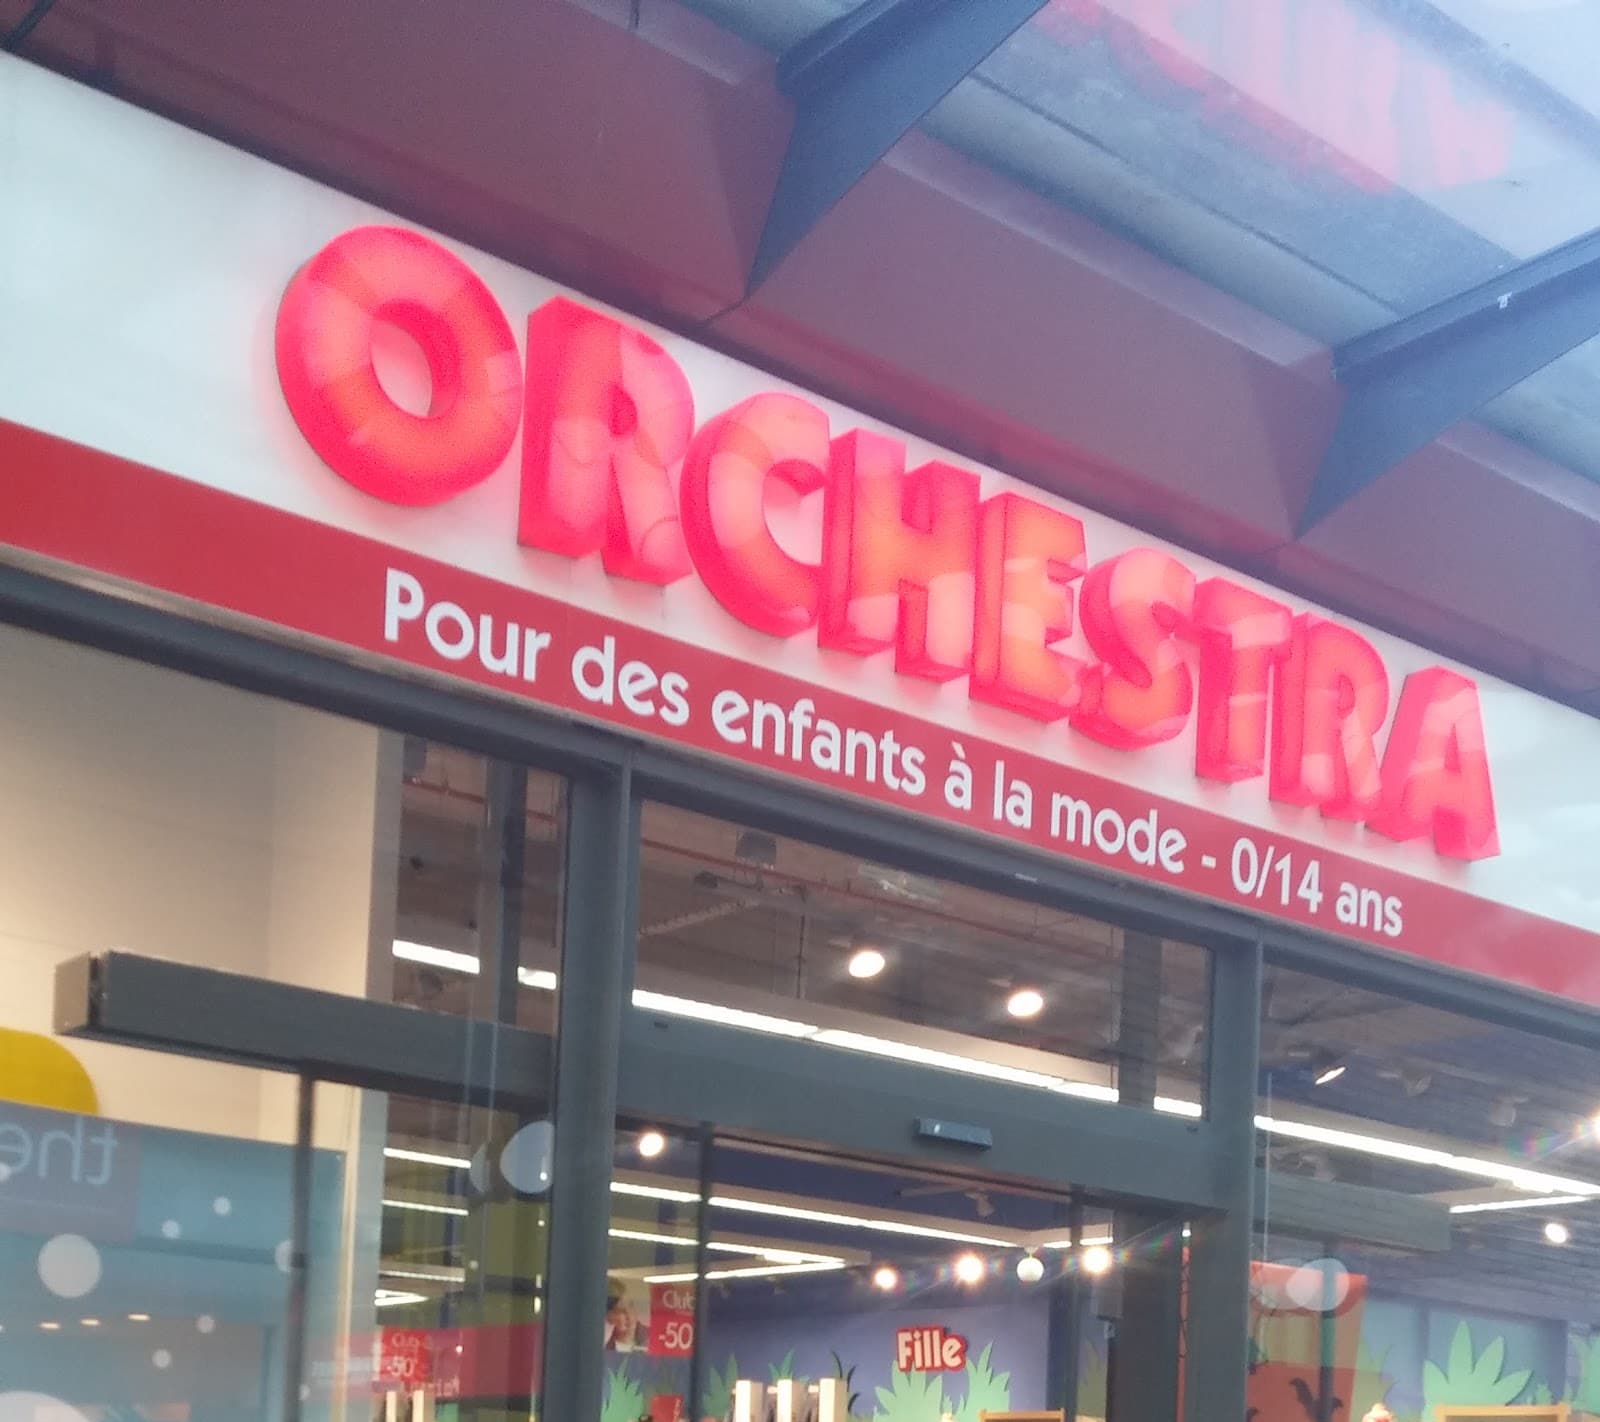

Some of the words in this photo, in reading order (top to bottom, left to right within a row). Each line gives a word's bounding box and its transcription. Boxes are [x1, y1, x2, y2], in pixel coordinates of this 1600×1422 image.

[274, 224, 1502, 863] ORCHESTRA
[384, 567, 552, 683] Pour
[571, 635, 691, 727] des
[711, 689, 927, 797] enfants
[943, 741, 973, 812] à
[992, 760, 1034, 830] la
[1049, 792, 1188, 875] mode
[1201, 854, 1217, 869] -
[1230, 836, 1325, 915] 0/14
[1334, 880, 1404, 939] ans
[897, 1329, 963, 1370] Fille
